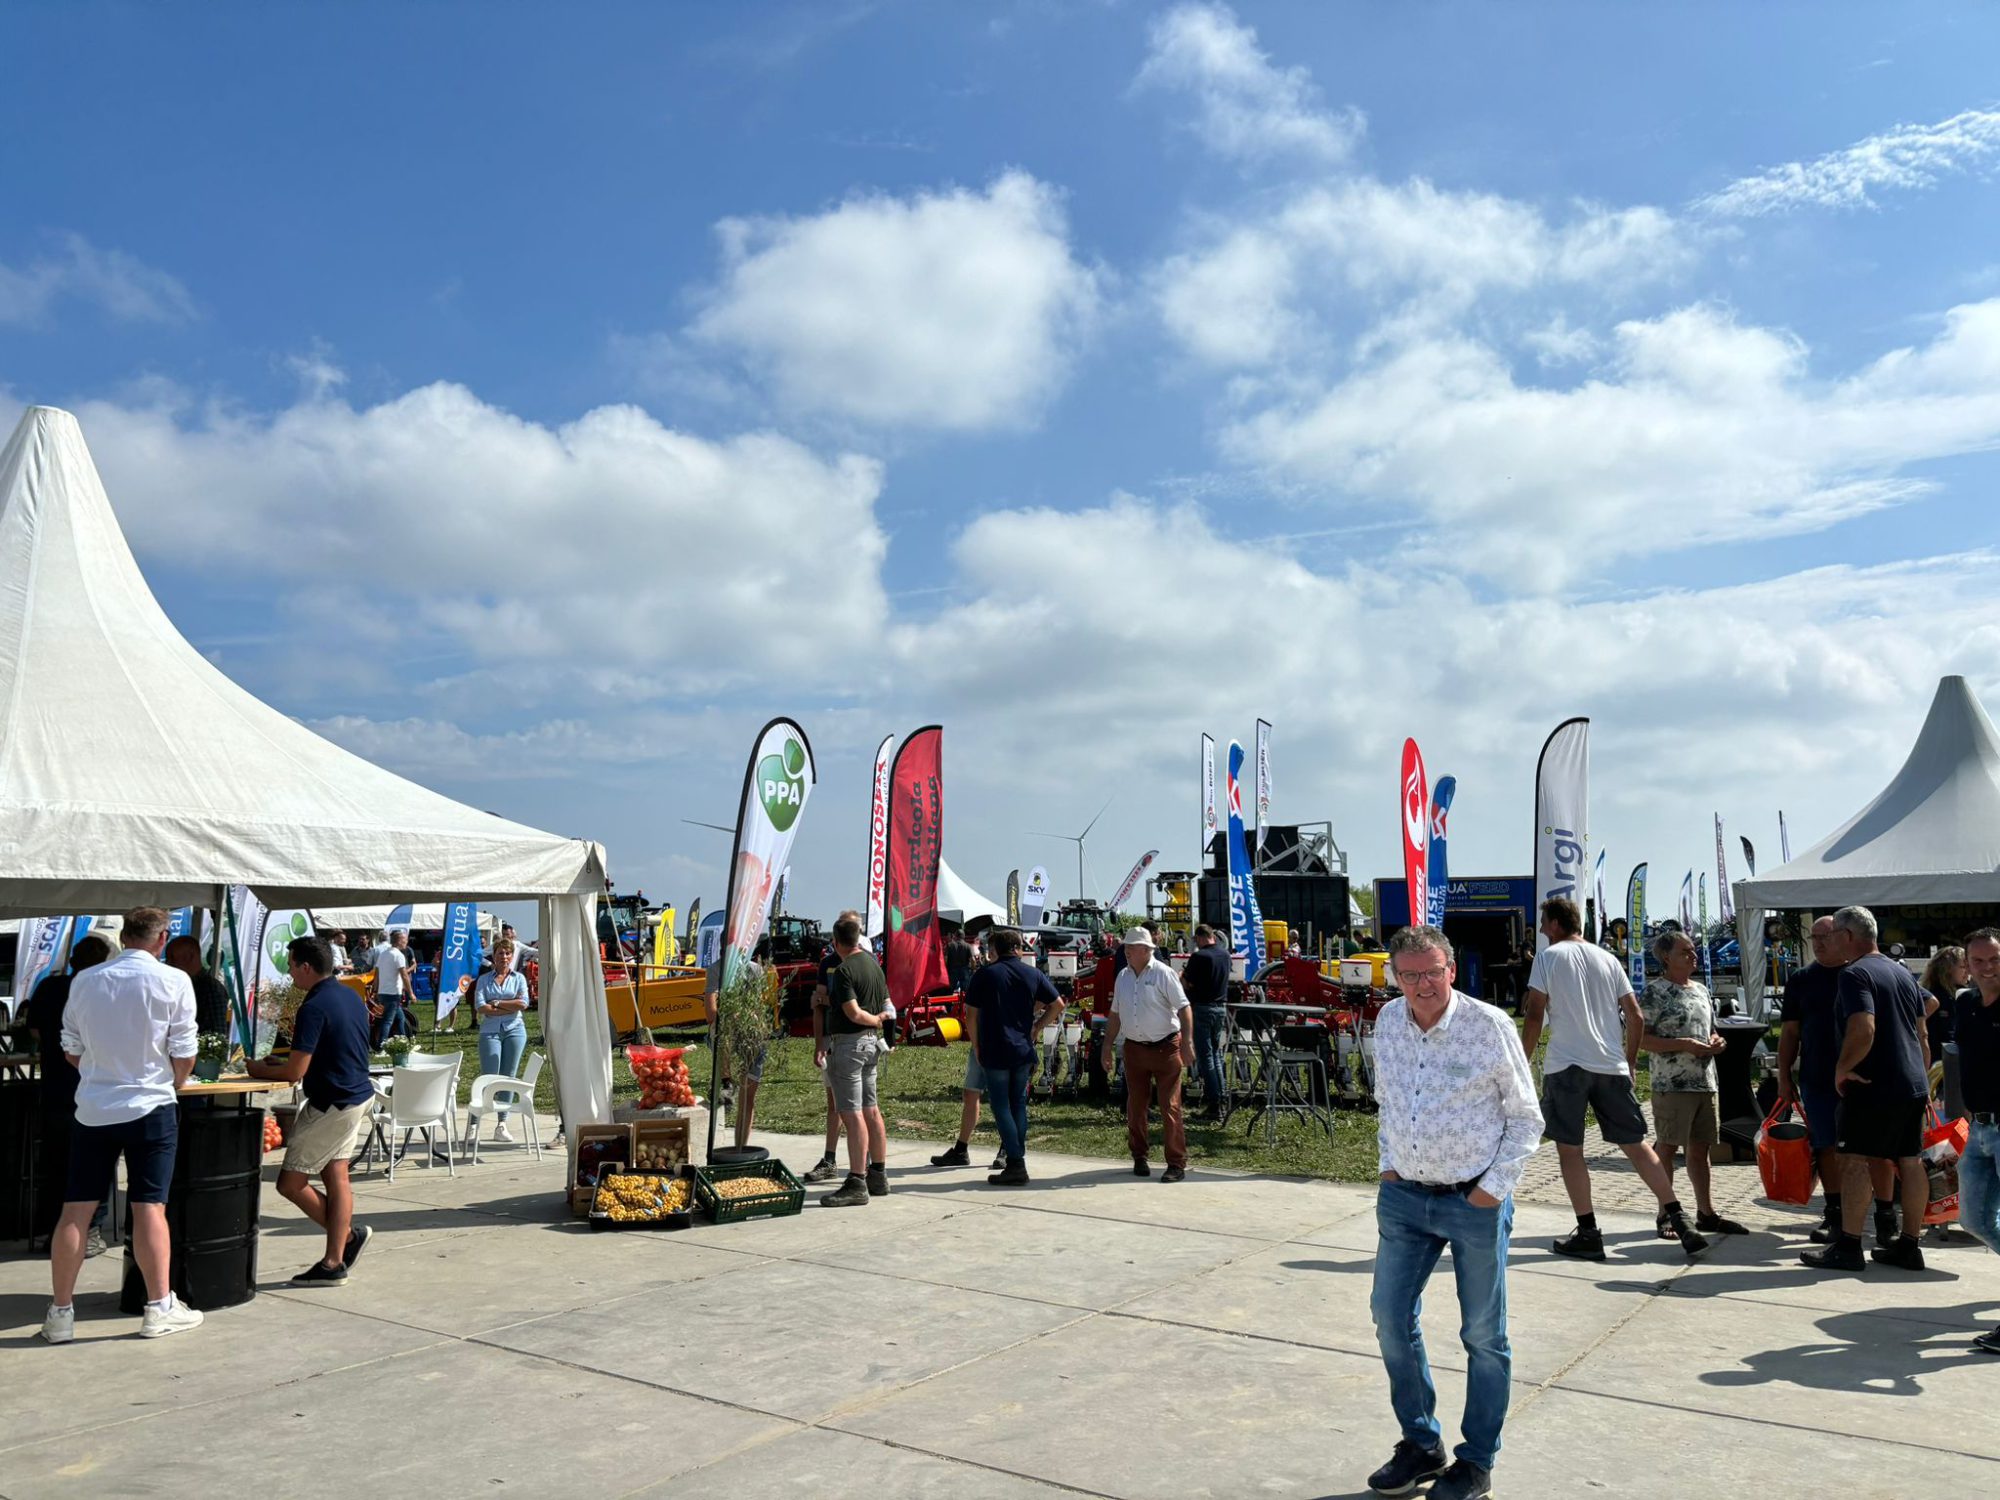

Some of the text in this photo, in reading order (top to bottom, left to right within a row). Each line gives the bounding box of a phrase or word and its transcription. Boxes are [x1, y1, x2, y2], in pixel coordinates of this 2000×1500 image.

[764, 780, 800, 805] PPA
[872, 760, 886, 909] MONOSEM
[908, 781, 925, 899] agricola
[1027, 885, 1045, 894] SKY
[1427, 886, 1438, 927] USE
[1447, 882, 1467, 894] UA
[31, 917, 46, 952] drainag
[249, 905, 266, 951] drainage
[446, 902, 470, 961] Squa
[1230, 873, 1251, 969] KRUSE
[1632, 877, 1643, 953] GIGANT
[271, 940, 289, 957] PP
